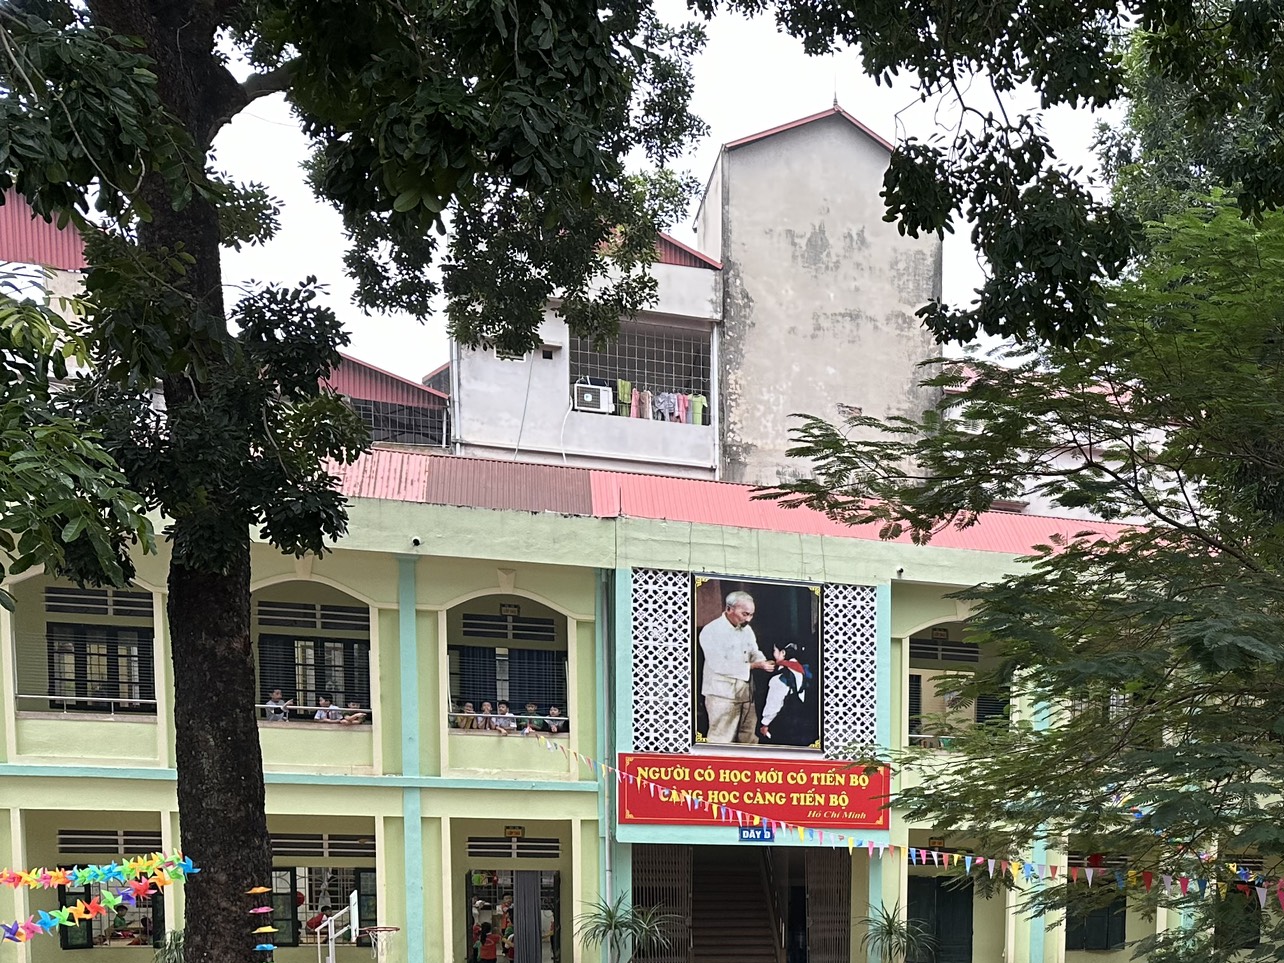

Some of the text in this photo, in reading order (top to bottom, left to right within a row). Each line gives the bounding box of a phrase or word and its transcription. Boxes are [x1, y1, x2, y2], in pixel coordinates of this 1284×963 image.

[637, 764, 690, 780] NGƯỜI
[694, 765, 715, 782] CÓ
[719, 769, 751, 785] HỌC
[755, 768, 783, 784] MỚI
[786, 769, 807, 785] CÓ
[811, 768, 845, 786] TIẾN
[708, 790, 740, 806] HỌC
[743, 788, 786, 805] CÀNG
[790, 788, 825, 806] TIẾN
[829, 791, 849, 809] BỘ
[843, 811, 867, 820] Minh
